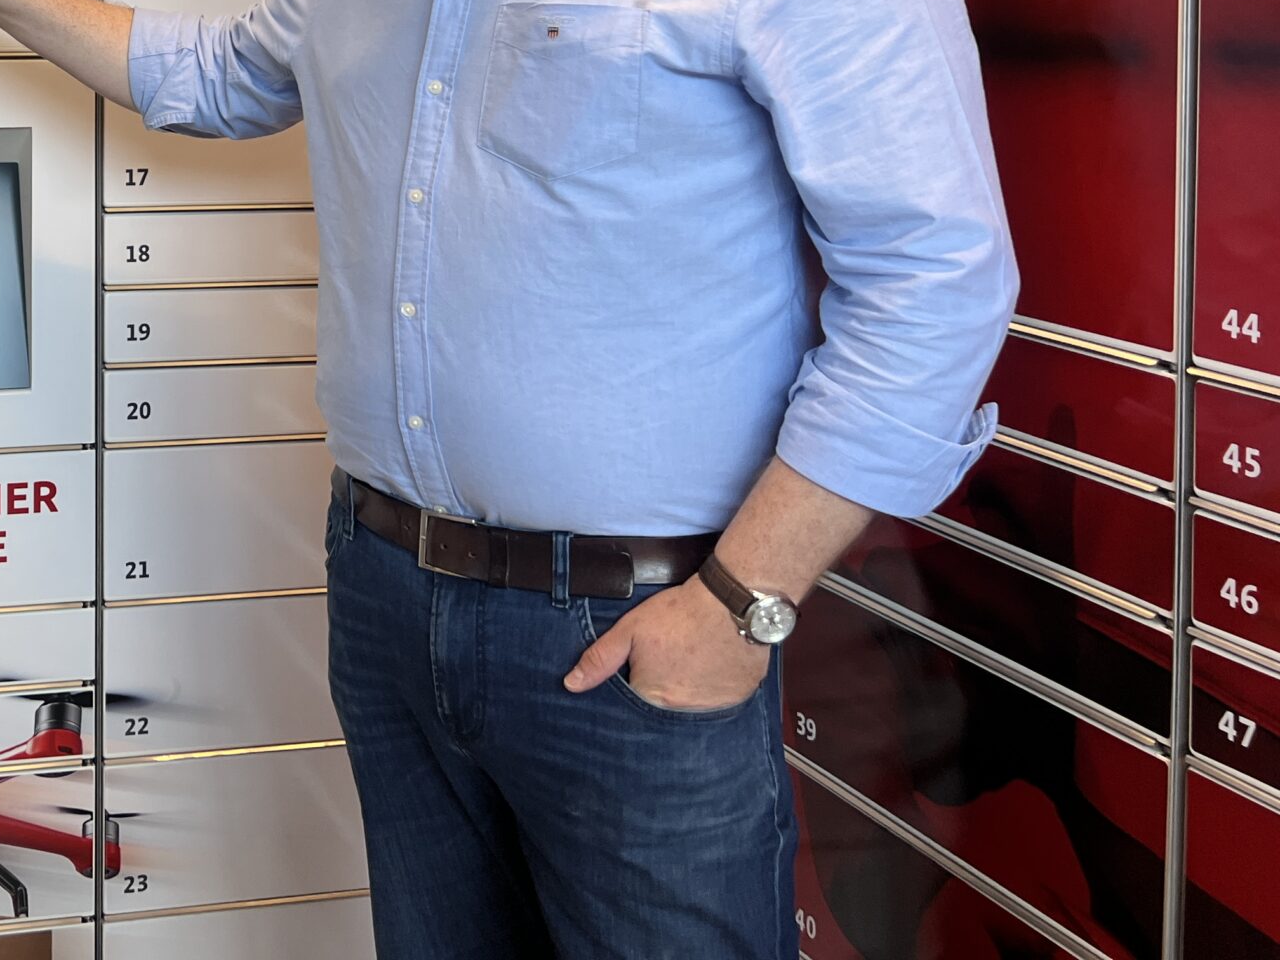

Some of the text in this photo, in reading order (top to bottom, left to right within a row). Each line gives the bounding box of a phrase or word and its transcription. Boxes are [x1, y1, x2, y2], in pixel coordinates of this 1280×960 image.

[126, 168, 149, 186] 17
[126, 245, 150, 262] 18
[126, 324, 151, 341] 19
[1221, 309, 1261, 343] 44
[126, 402, 151, 420] 20
[1222, 444, 1261, 478] 45
[125, 561, 150, 579] 21
[1220, 578, 1259, 614] 46
[124, 718, 149, 736] 22
[796, 711, 817, 741] 39
[1219, 710, 1257, 748] 47
[124, 874, 149, 893] 23
[795, 908, 817, 939] 40
